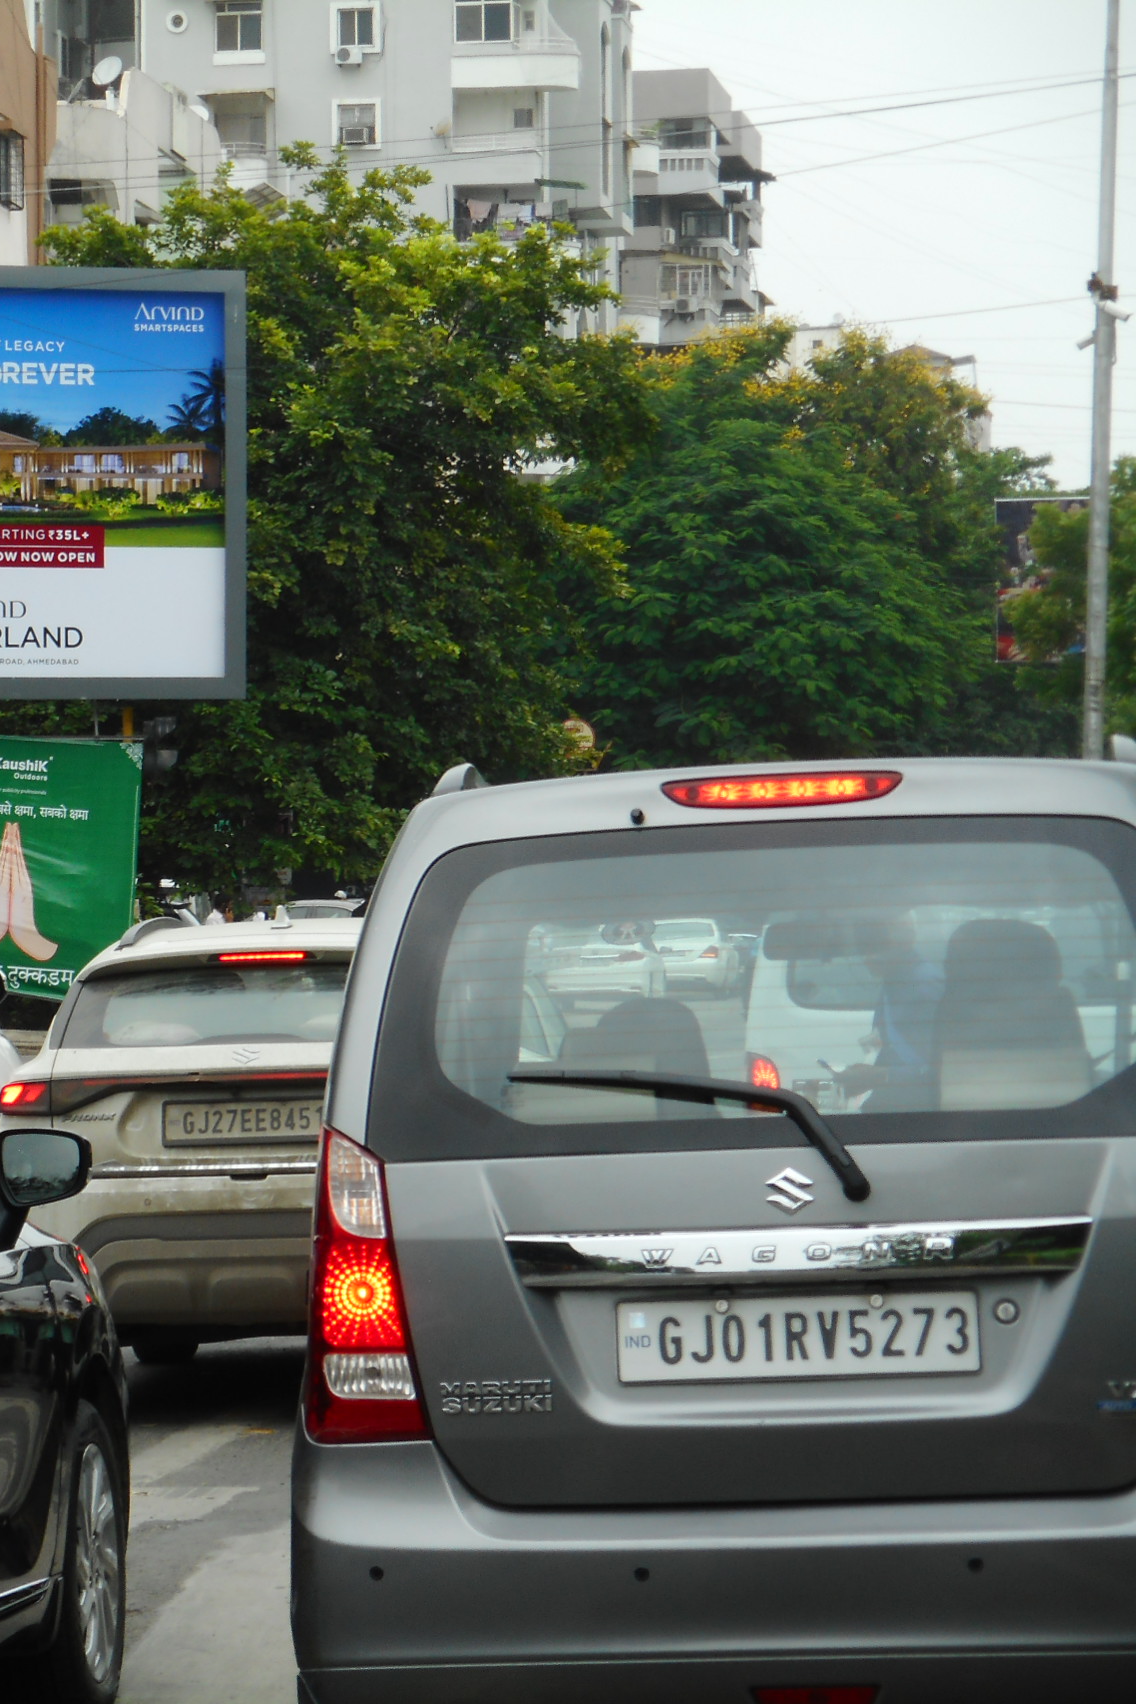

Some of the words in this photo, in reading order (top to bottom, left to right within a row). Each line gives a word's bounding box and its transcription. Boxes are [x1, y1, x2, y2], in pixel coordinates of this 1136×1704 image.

[134, 323, 205, 332] SMARTSPACES
[4, 340, 65, 352] LEGACY
[20, 552, 54, 562] NOW
[58, 552, 96, 563] OPEN
[27, 658, 79, 666] AHMEDABAD
[13, 772, 48, 781] Outdoors
[69, 809, 89, 820] क्षमा
[625, 1335, 651, 1349] IND
[658, 1307, 970, 1365] GJ01RV5273
[440, 1379, 551, 1396] MARUTI
[441, 1394, 552, 1413] SUZUKI
